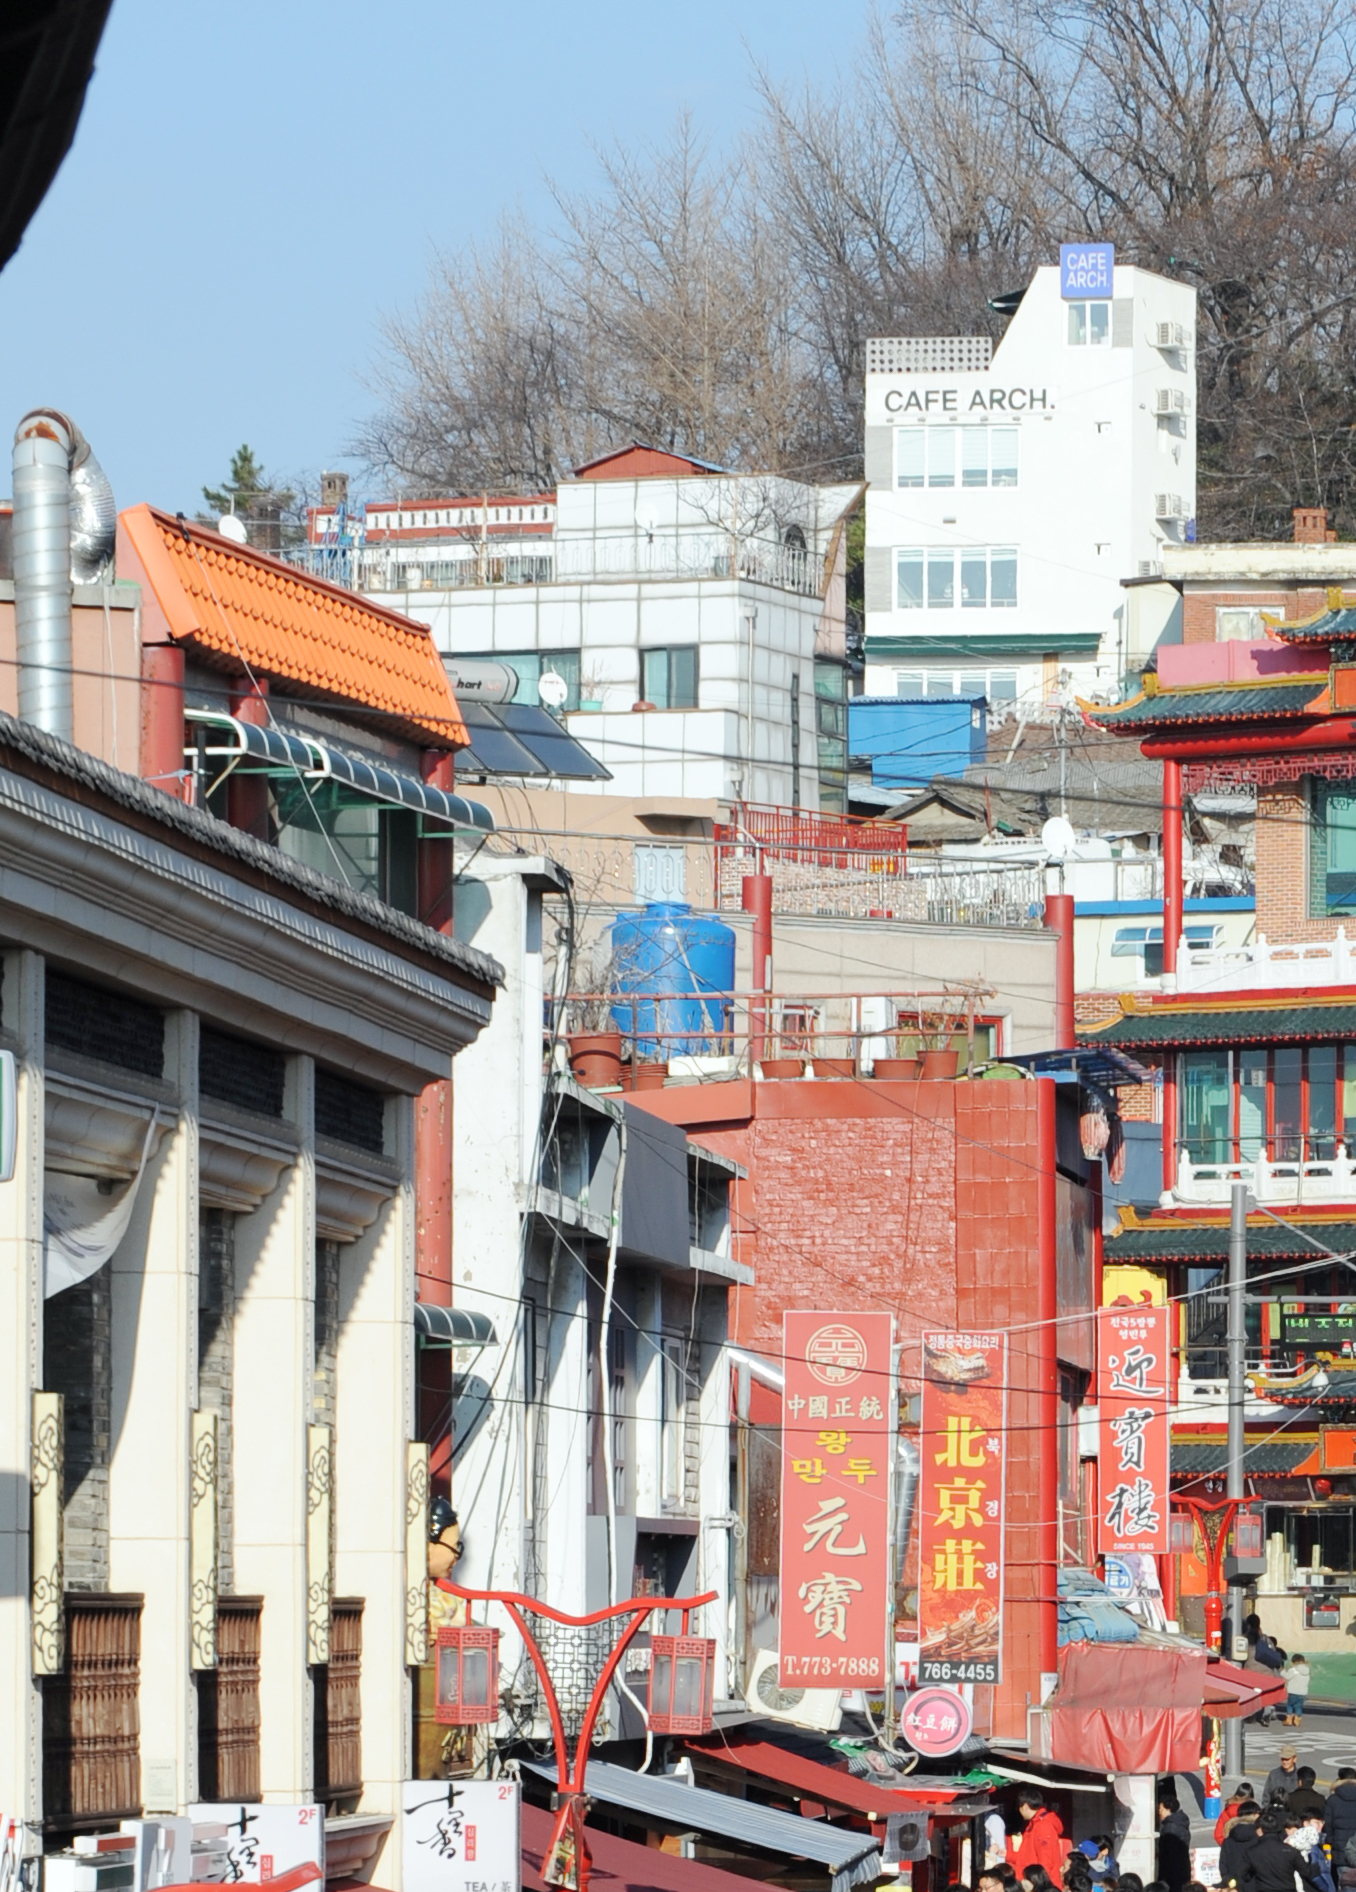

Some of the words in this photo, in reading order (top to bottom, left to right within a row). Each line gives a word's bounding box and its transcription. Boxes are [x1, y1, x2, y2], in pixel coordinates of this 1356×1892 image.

[1067, 252, 1107, 271] CAFE
[884, 388, 958, 412] CAFE
[968, 387, 1056, 411] ARCH.
[787, 1393, 884, 1421] 中國正統
[815, 1429, 852, 1454] 왕
[933, 1415, 987, 1591] 北京莊
[798, 1496, 868, 1643] 元寶
[783, 1655, 880, 1677] T.773-7888
[923, 1662, 995, 1680] 766-4455
[498, 1785, 514, 1800] 2F
[298, 1808, 317, 1825] 2F
[464, 1881, 488, 1892] TEA
